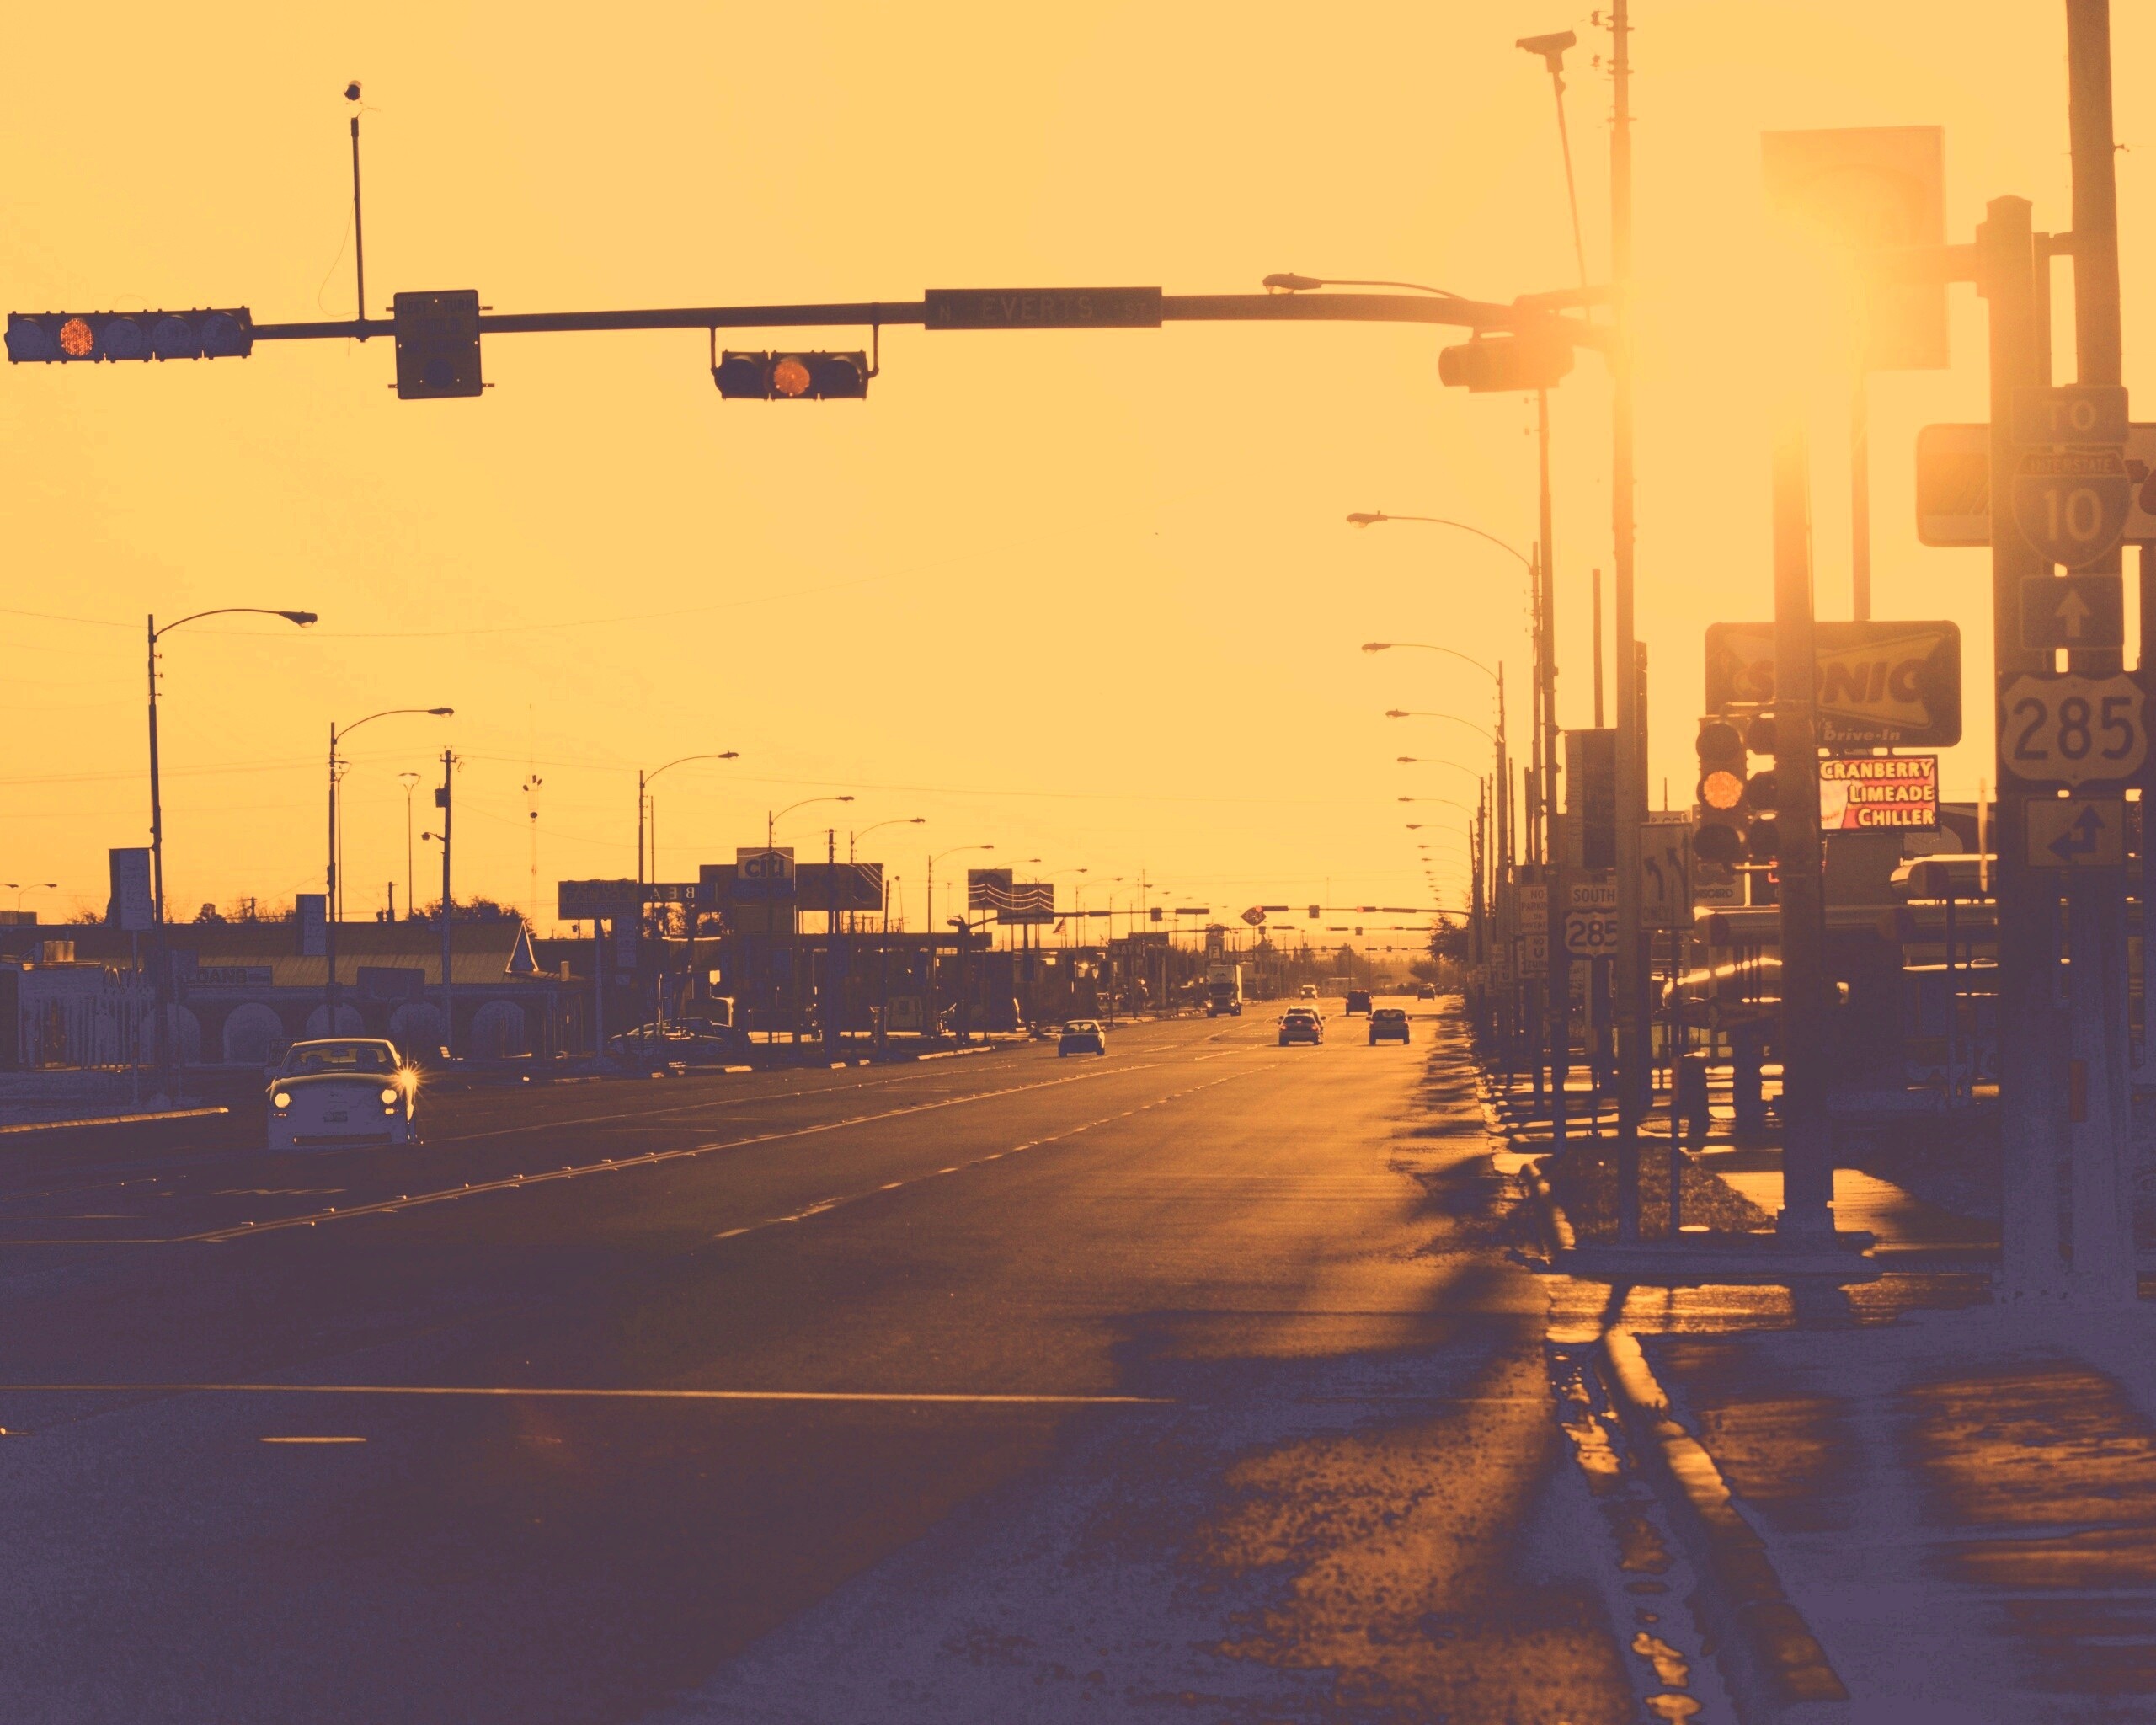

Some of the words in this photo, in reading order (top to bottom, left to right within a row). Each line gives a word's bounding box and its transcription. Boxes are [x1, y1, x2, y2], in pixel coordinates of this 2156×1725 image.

[443, 298, 474, 312] TURN
[939, 304, 951, 322] N
[980, 295, 1094, 321] EVERTS
[2043, 399, 2096, 432] TO
[2030, 458, 2111, 473] INTERSTATE
[2042, 487, 2103, 542] 10
[1748, 657, 1929, 705] SNIC
[1824, 728, 1901, 742] Drive-In
[2013, 696, 2134, 761] 285
[1820, 761, 1934, 780] CRANBERRY
[1849, 784, 1934, 803] LIMEADE
[1858, 808, 1935, 826] CHILLER
[744, 856, 785, 878] citi
[1530, 889, 1544, 900] NO
[1573, 888, 1615, 903] SOUTH
[1522, 902, 1548, 911] PARKIN
[1569, 920, 1618, 947] 285
[1533, 948, 1545, 959] U
